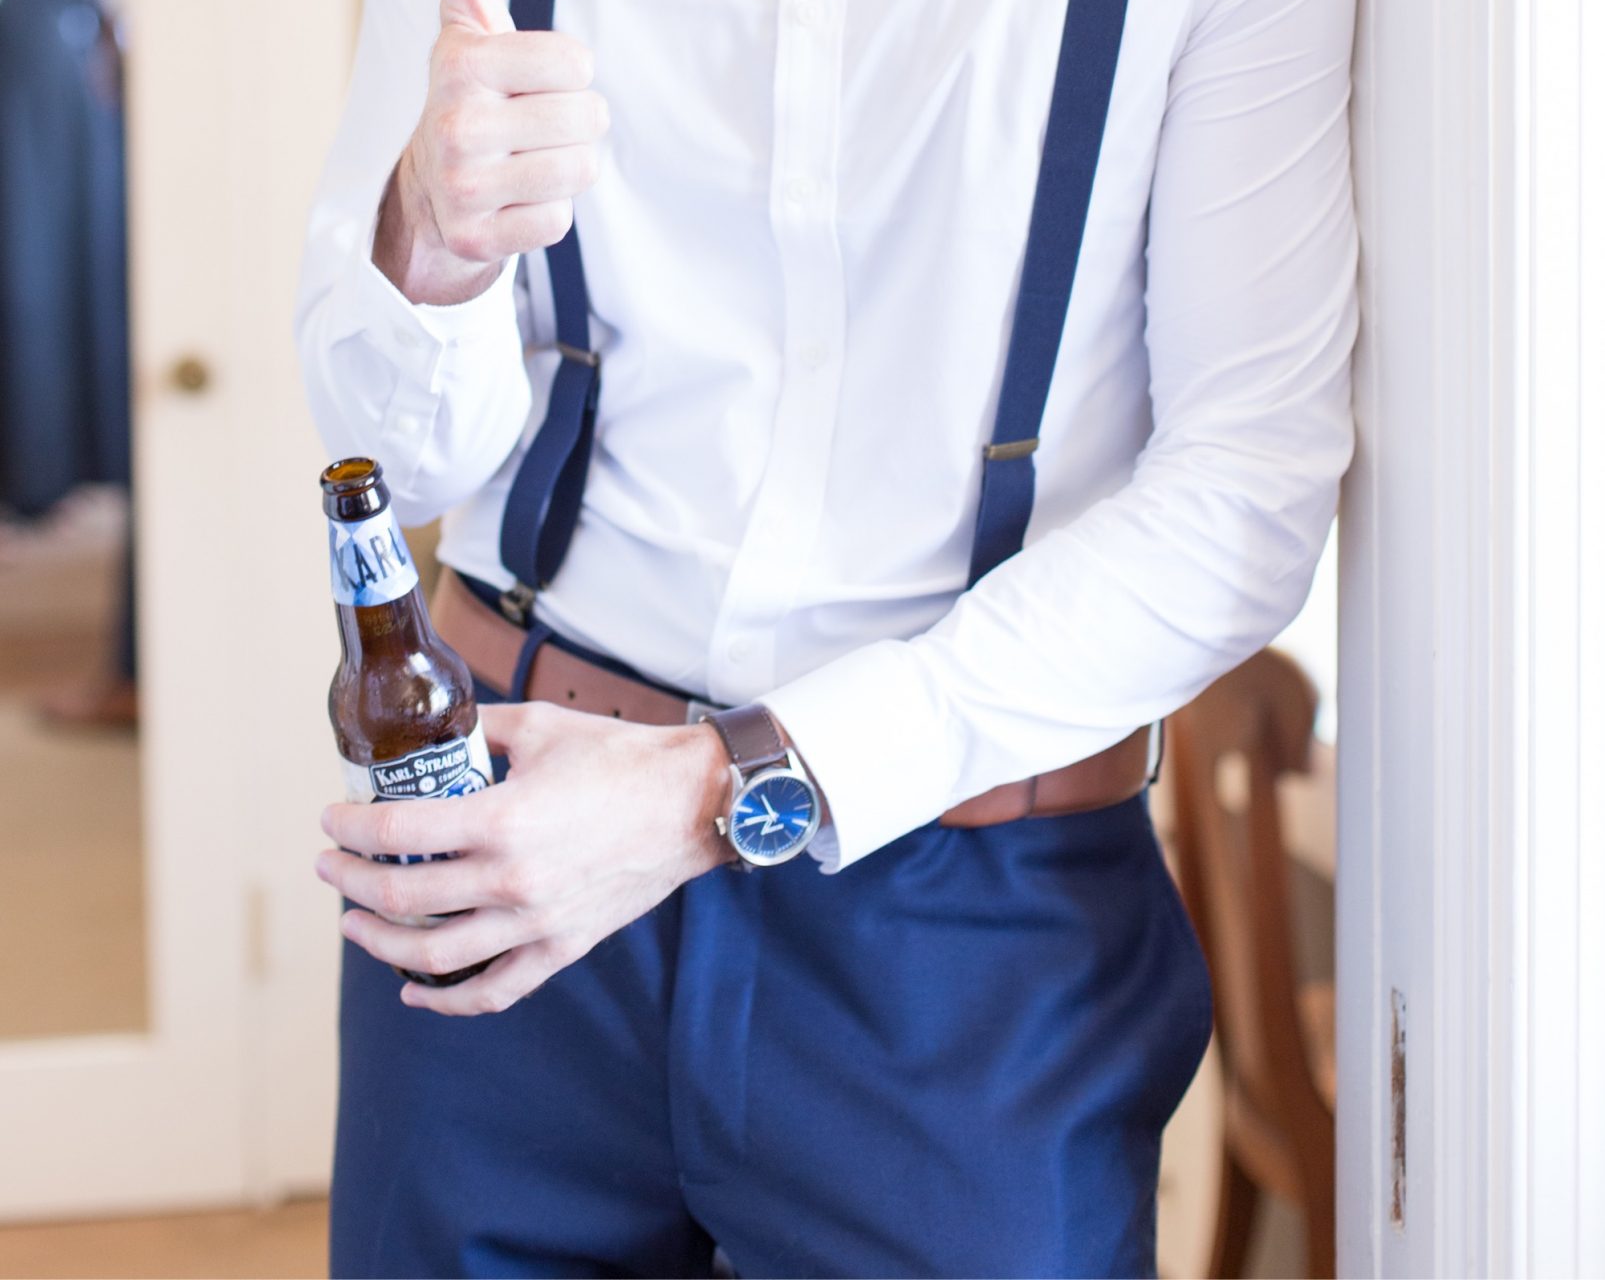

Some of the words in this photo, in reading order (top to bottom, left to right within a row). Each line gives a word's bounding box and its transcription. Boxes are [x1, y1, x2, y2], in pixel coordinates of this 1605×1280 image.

[334, 528, 407, 592] KARL
[375, 767, 415, 787] KARL
[413, 749, 467, 777] STRAUSS
